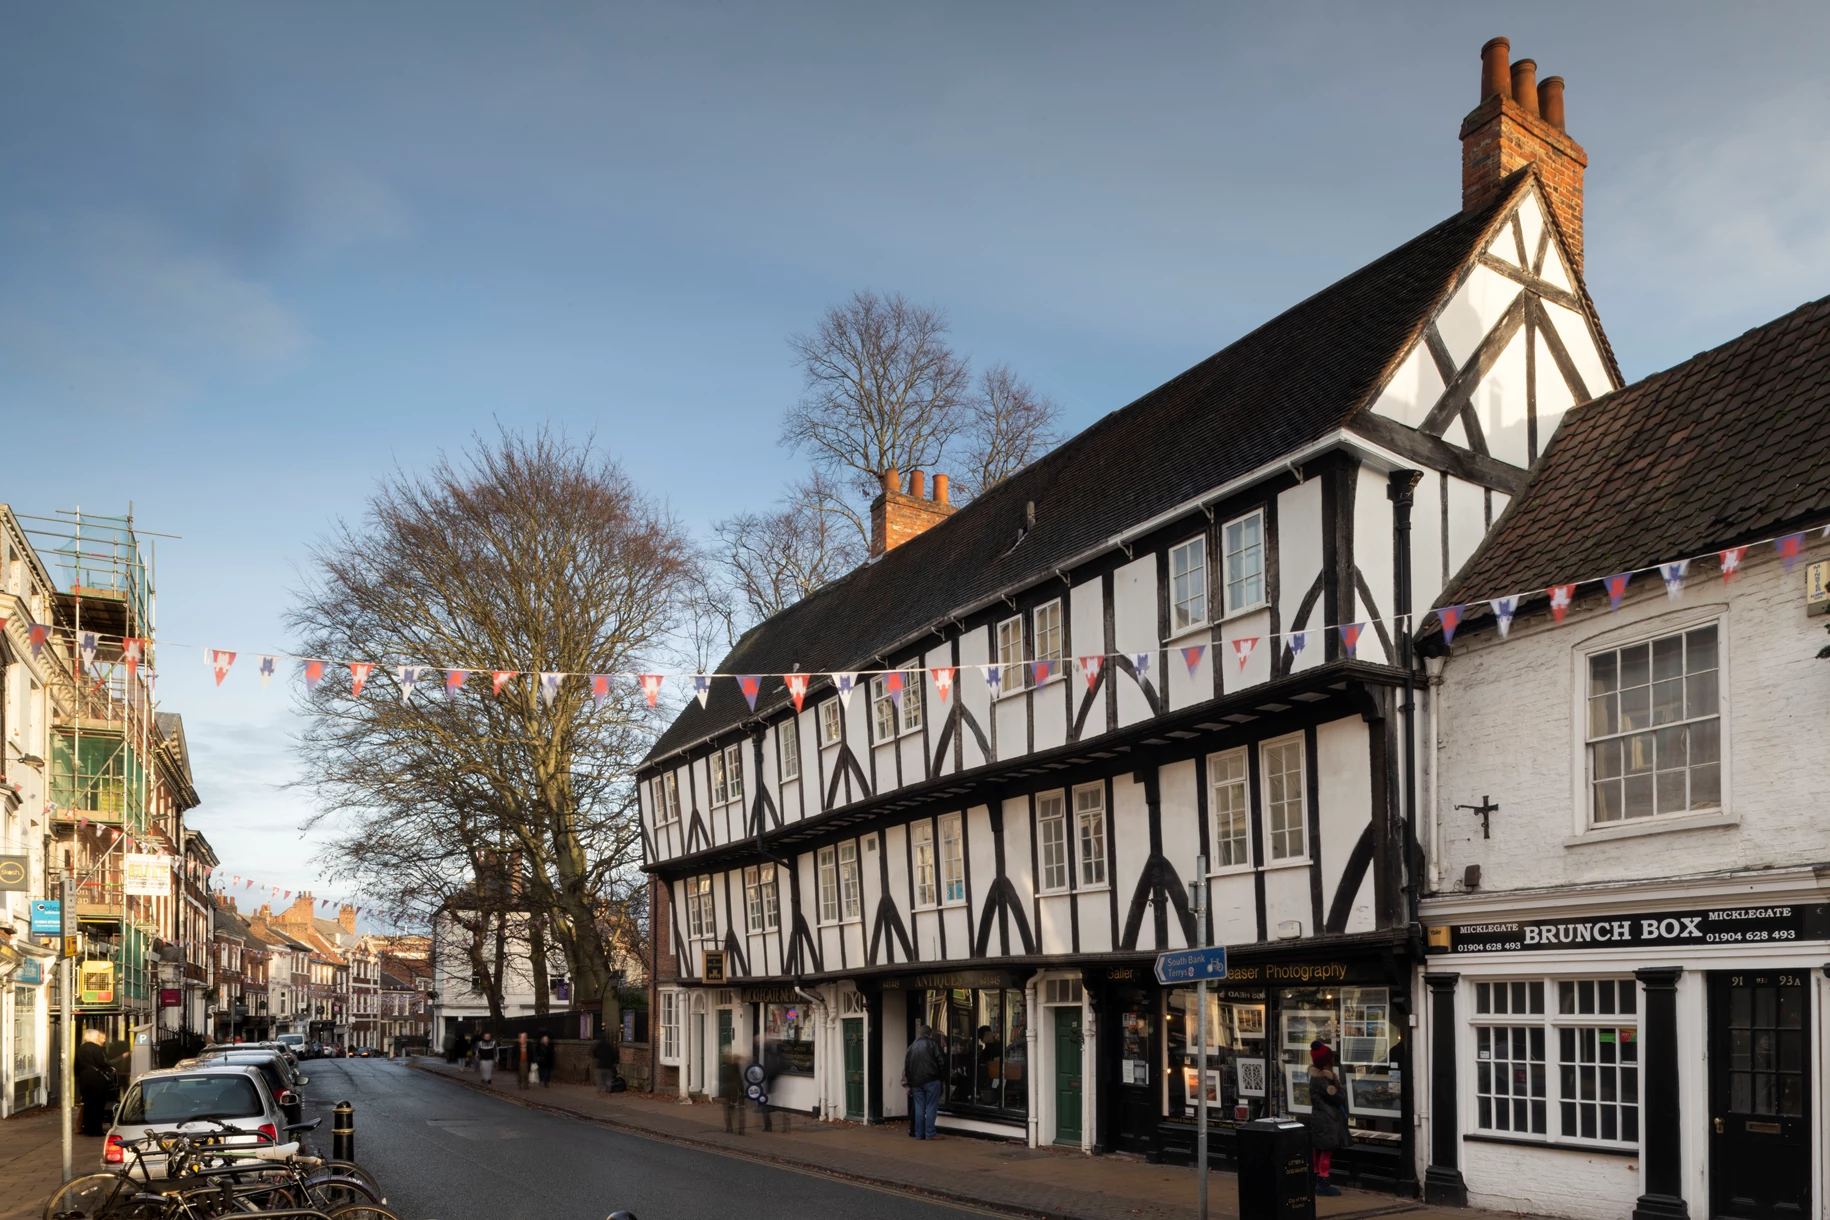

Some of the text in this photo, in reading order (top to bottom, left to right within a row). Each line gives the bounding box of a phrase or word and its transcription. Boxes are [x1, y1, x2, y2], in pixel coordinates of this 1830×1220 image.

[1708, 907, 1792, 920] MICKLEGATE
[1460, 924, 1519, 934] MICKLEGATE
[1524, 917, 1702, 944] BRUNCH BOX
[1706, 930, 1796, 942] 01904 628 493
[1458, 942, 1520, 952] 01904 628 493
[1168, 954, 1206, 967] South Bank
[1107, 966, 1134, 980] Galler
[1168, 968, 1188, 978] Terrys
[1227, 962, 1347, 980] easer Photography
[915, 976, 963, 989] ANTIQUES
[1732, 976, 1743, 986] 91
[140, 1034, 147, 1044] P
